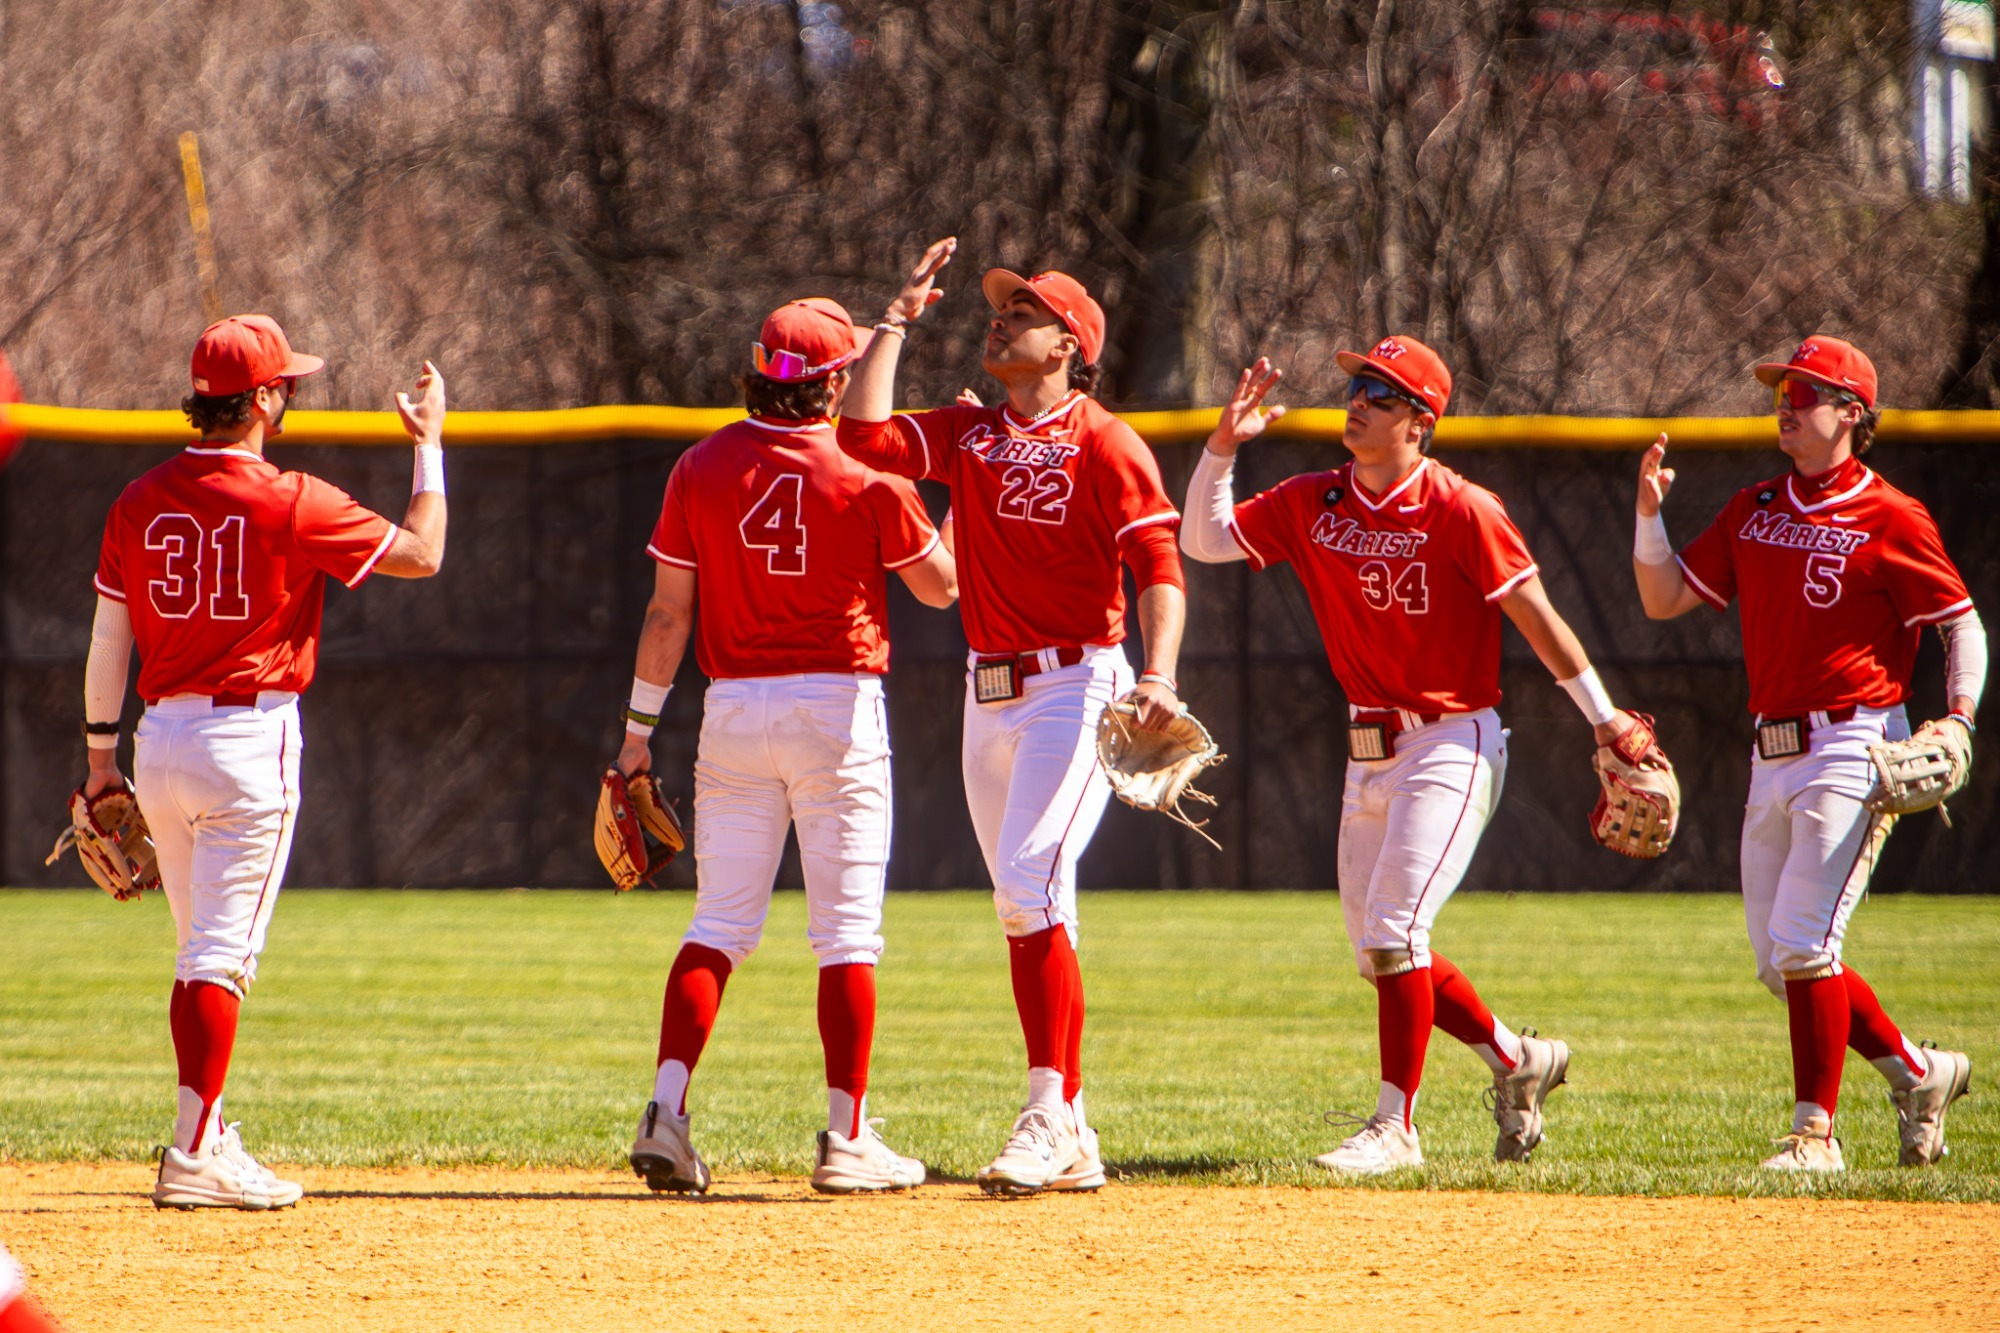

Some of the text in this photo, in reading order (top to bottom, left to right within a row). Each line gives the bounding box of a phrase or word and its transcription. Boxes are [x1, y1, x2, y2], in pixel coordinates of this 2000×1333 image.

[997, 465, 1073, 525] 22
[739, 473, 806, 576] 4
[1310, 511, 1428, 558] MARIST
[1739, 509, 1870, 555] MARIST
[144, 512, 249, 620] 31
[1358, 560, 1429, 615] 34
[1803, 552, 1847, 609] 5
